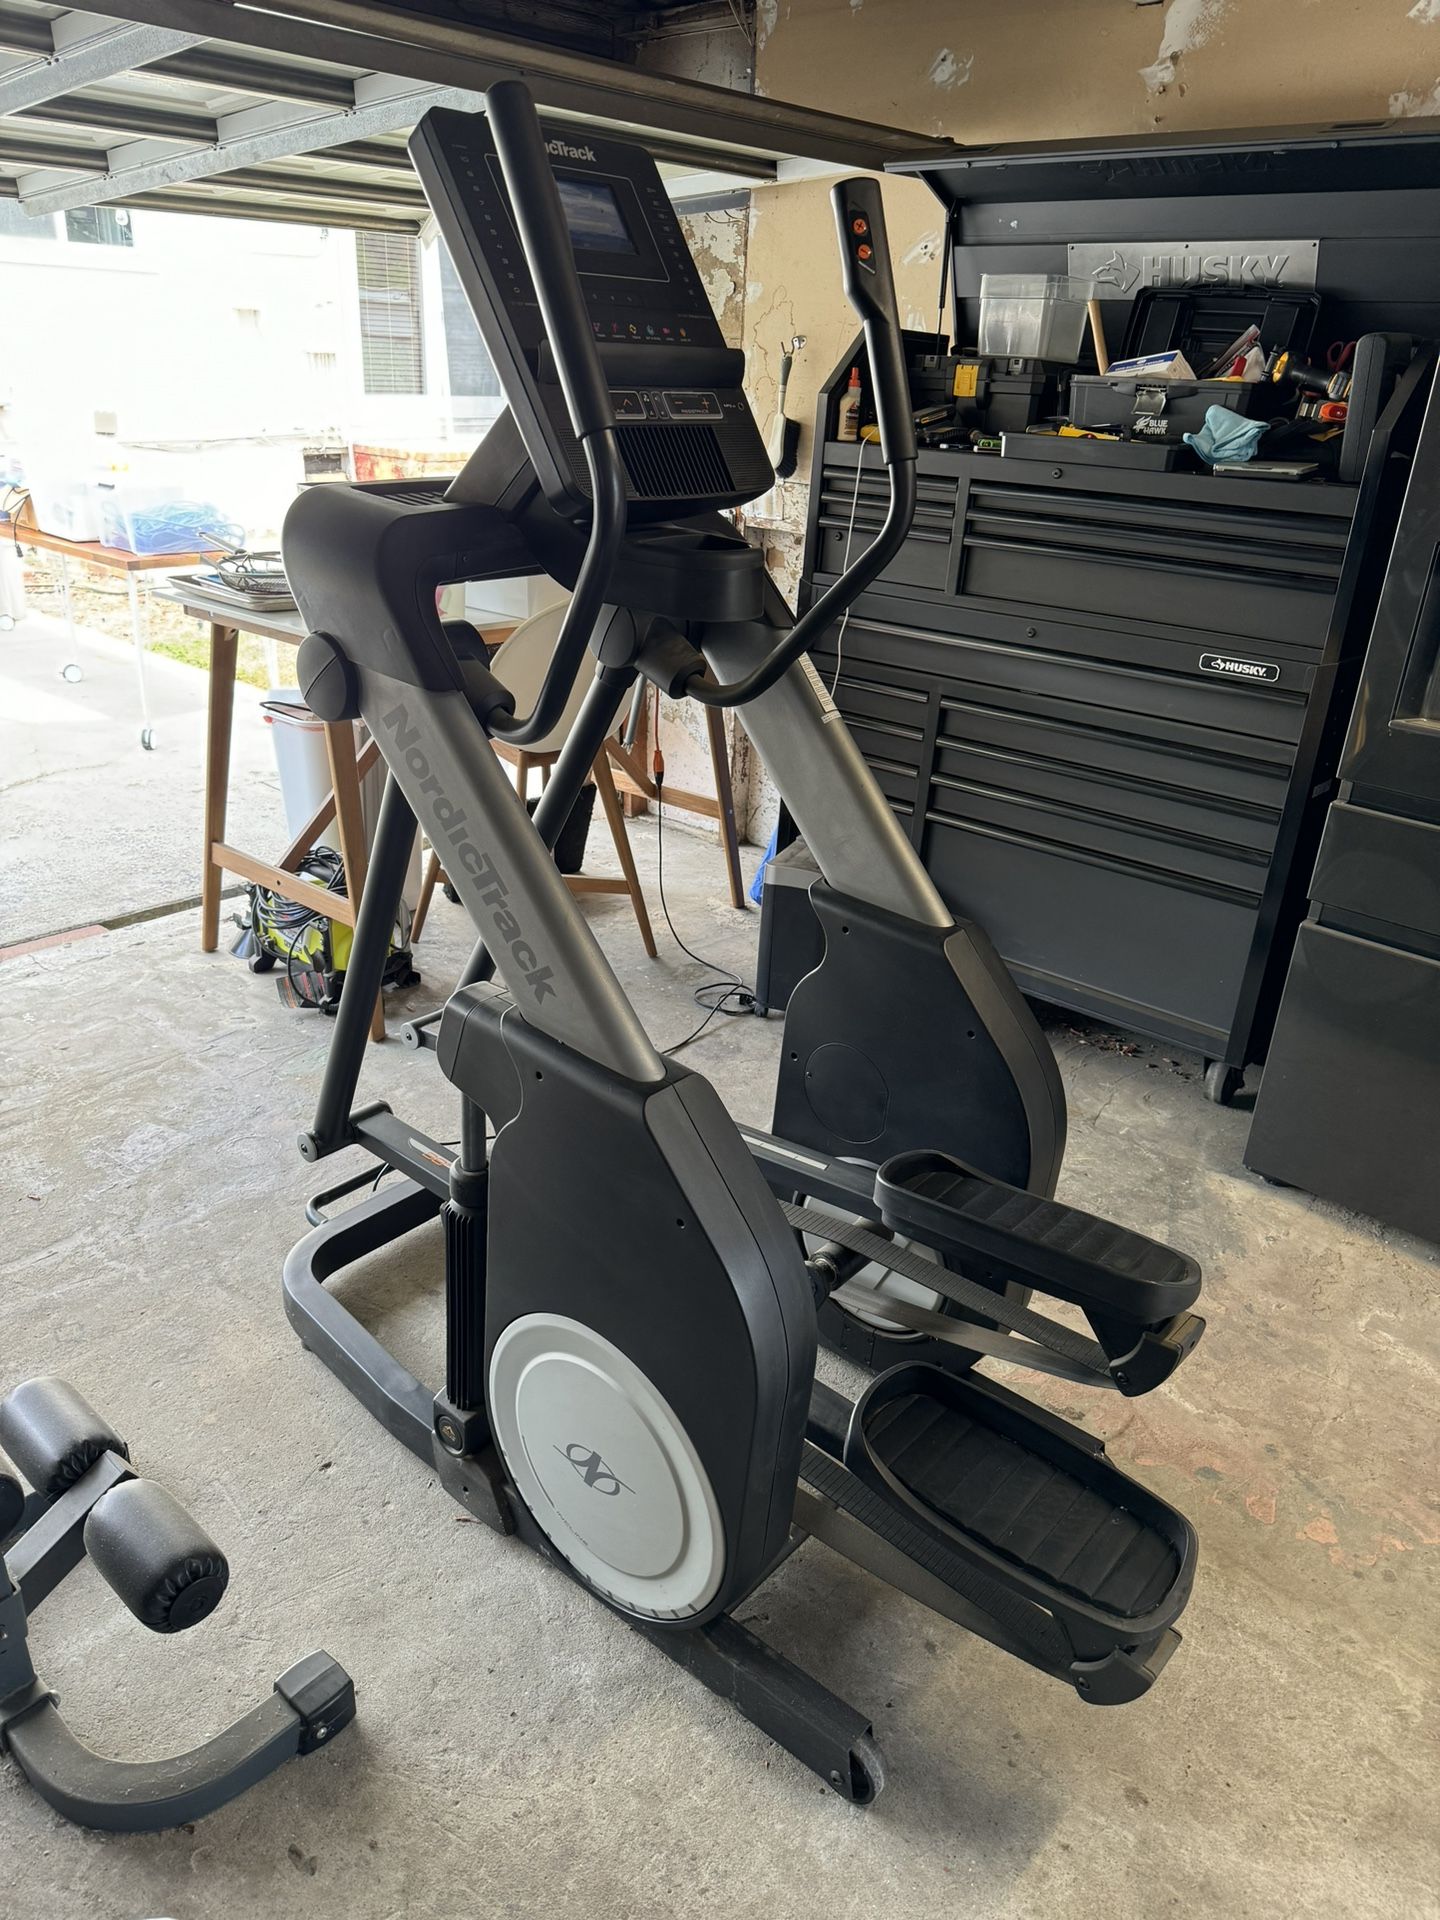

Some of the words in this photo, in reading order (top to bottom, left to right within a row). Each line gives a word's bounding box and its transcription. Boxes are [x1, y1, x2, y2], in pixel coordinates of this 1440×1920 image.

[544, 139, 597, 161] icTrack
[1143, 427, 1167, 435] HAWK
[1149, 419, 1168, 428] BLUE
[382, 703, 557, 1005] NordicTrack
